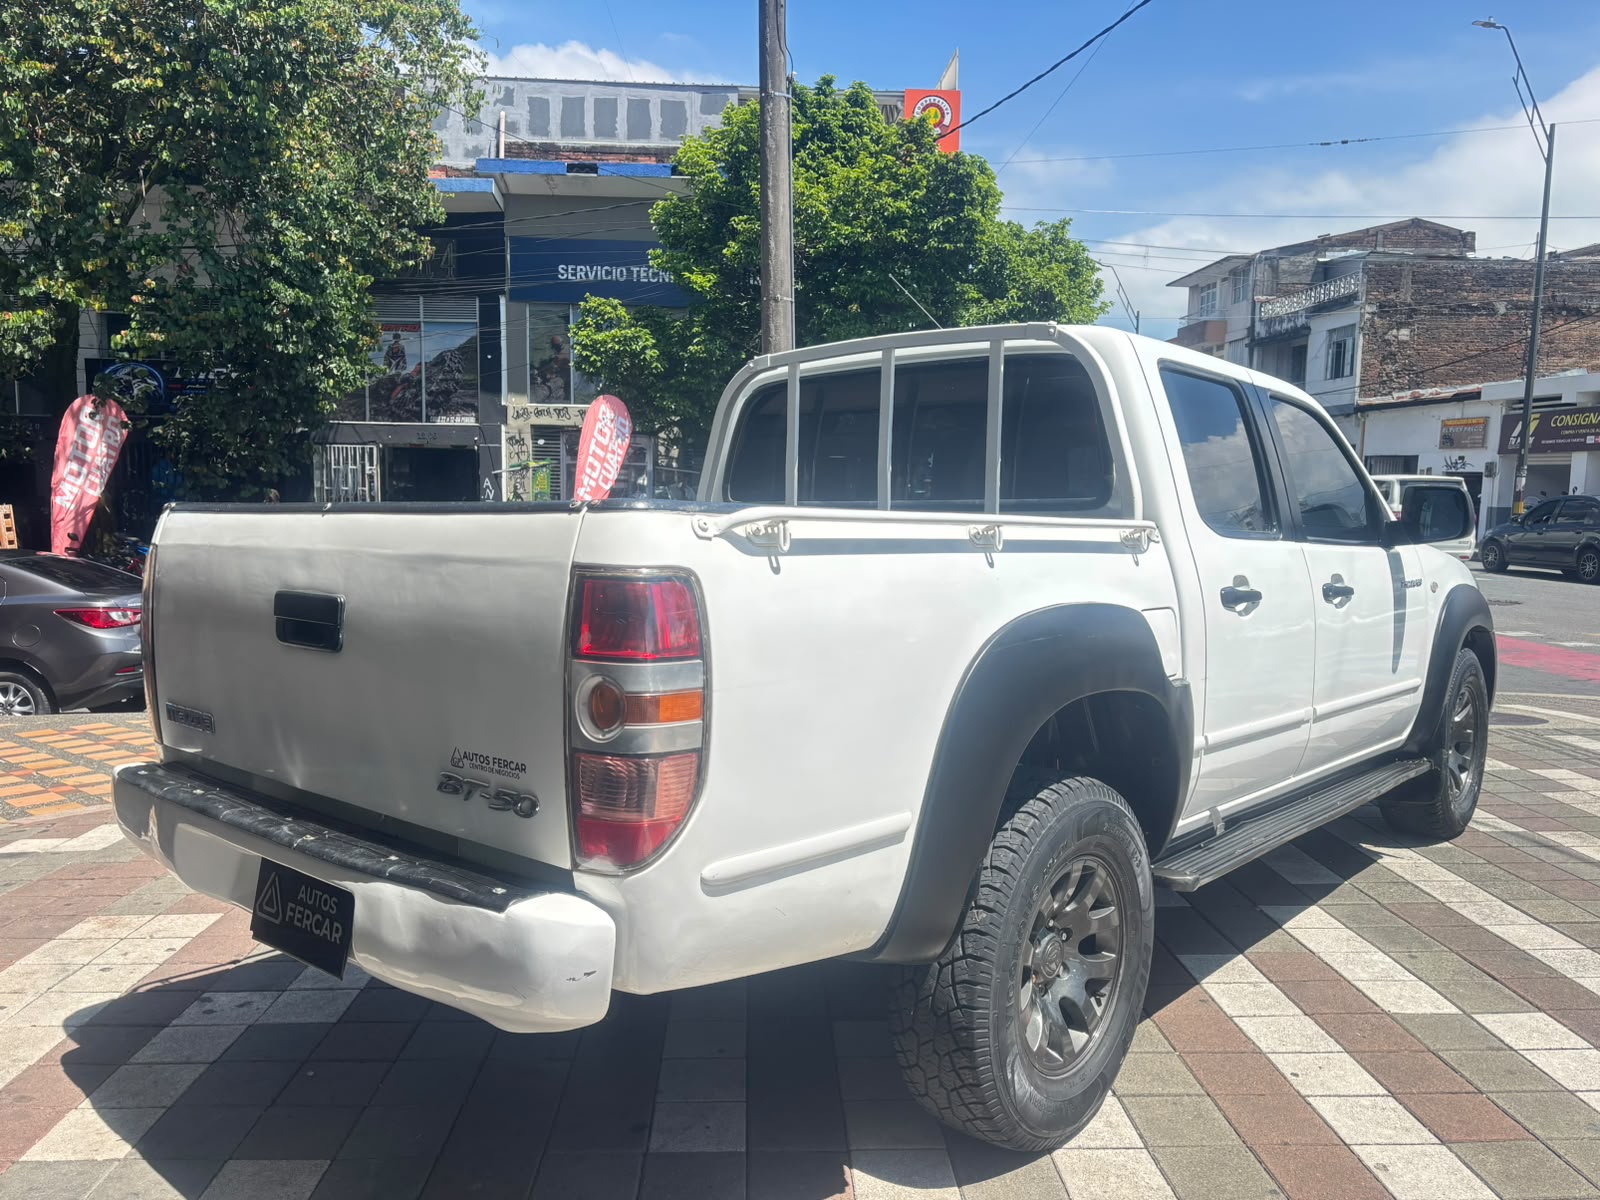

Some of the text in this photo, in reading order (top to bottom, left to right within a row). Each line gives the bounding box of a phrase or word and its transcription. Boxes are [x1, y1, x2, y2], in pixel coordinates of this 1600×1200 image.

[558, 264, 627, 284] SERVICIO
[463, 751, 527, 774] AUTOS FERCAR
[469, 762, 488, 774] CENTRO
[495, 768, 521, 780] NEGOCIOS
[436, 771, 540, 818] BT-50
[298, 885, 338, 914] AUTOS
[285, 902, 343, 944] FERCAR
